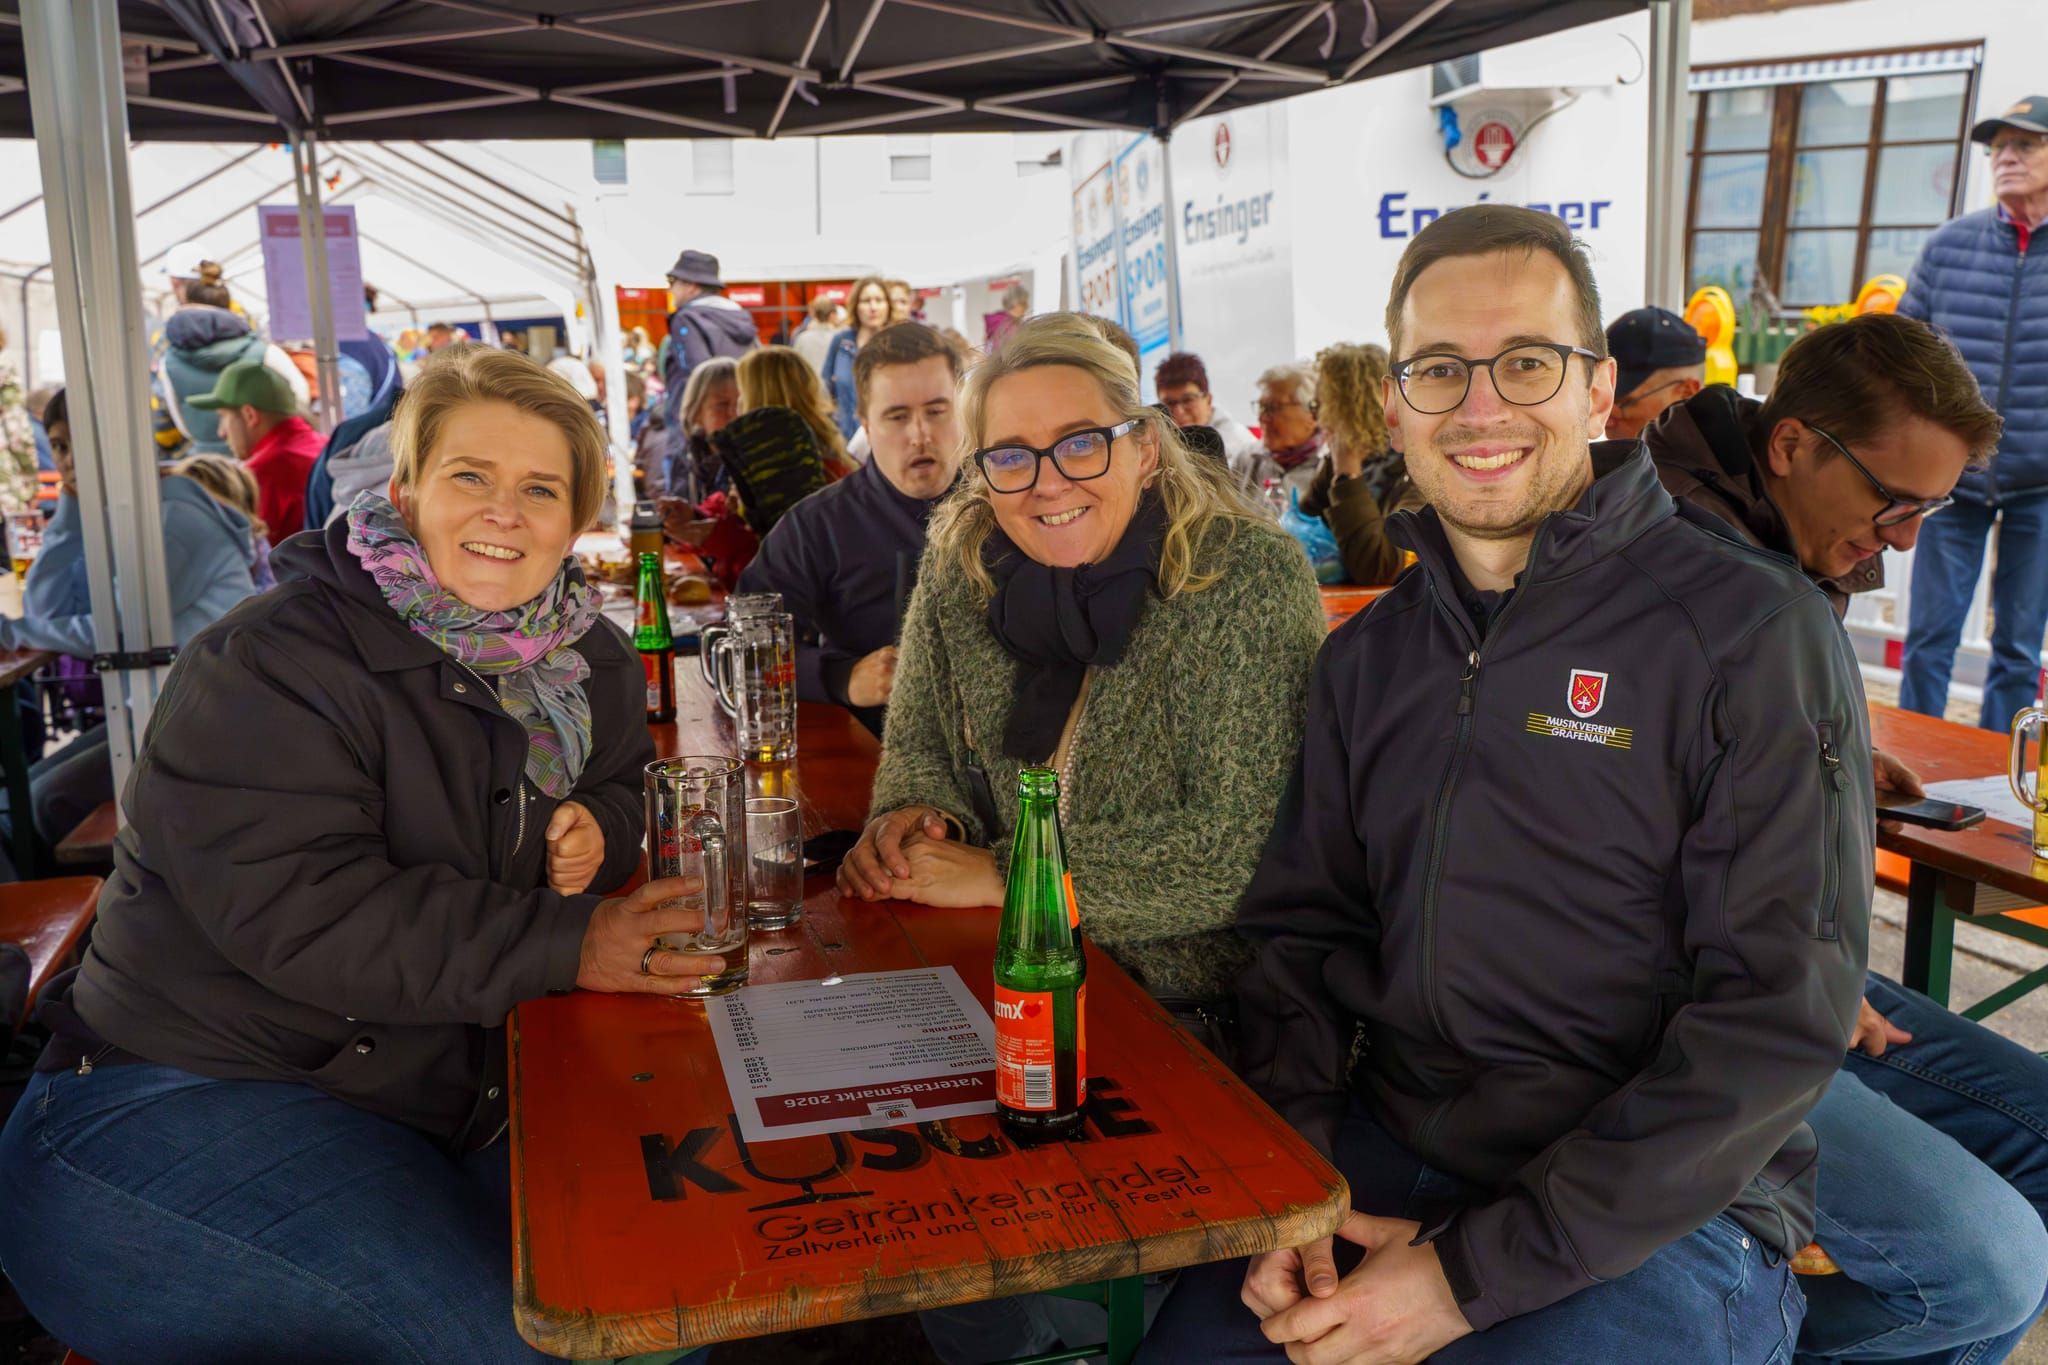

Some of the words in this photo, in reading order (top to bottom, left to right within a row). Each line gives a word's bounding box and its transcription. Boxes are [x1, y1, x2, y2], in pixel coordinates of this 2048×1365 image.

[1184, 192, 1274, 245] Ensinger
[1377, 192, 1612, 238] Ener
[1127, 242, 1167, 301] SPOR
[1546, 716, 1616, 736] MUSIKVEREIN
[1551, 728, 1607, 745] GRAFENAU
[921, 1024, 972, 1033] Getränke
[942, 1042, 983, 1050] Currywurst
[869, 1062, 906, 1070] Brötchen
[892, 1054, 929, 1062] Brötchen
[949, 1058, 996, 1068] Speisen
[834, 1076, 983, 1102] Vatertagsmarkt
[784, 1095, 831, 1108] 2026
[756, 1155, 1201, 1242] Getränkehandel
[765, 1226, 917, 1261] Zeltverleih
[990, 1205, 1054, 1227] alles
[1126, 1181, 1213, 1207] Fest'le
